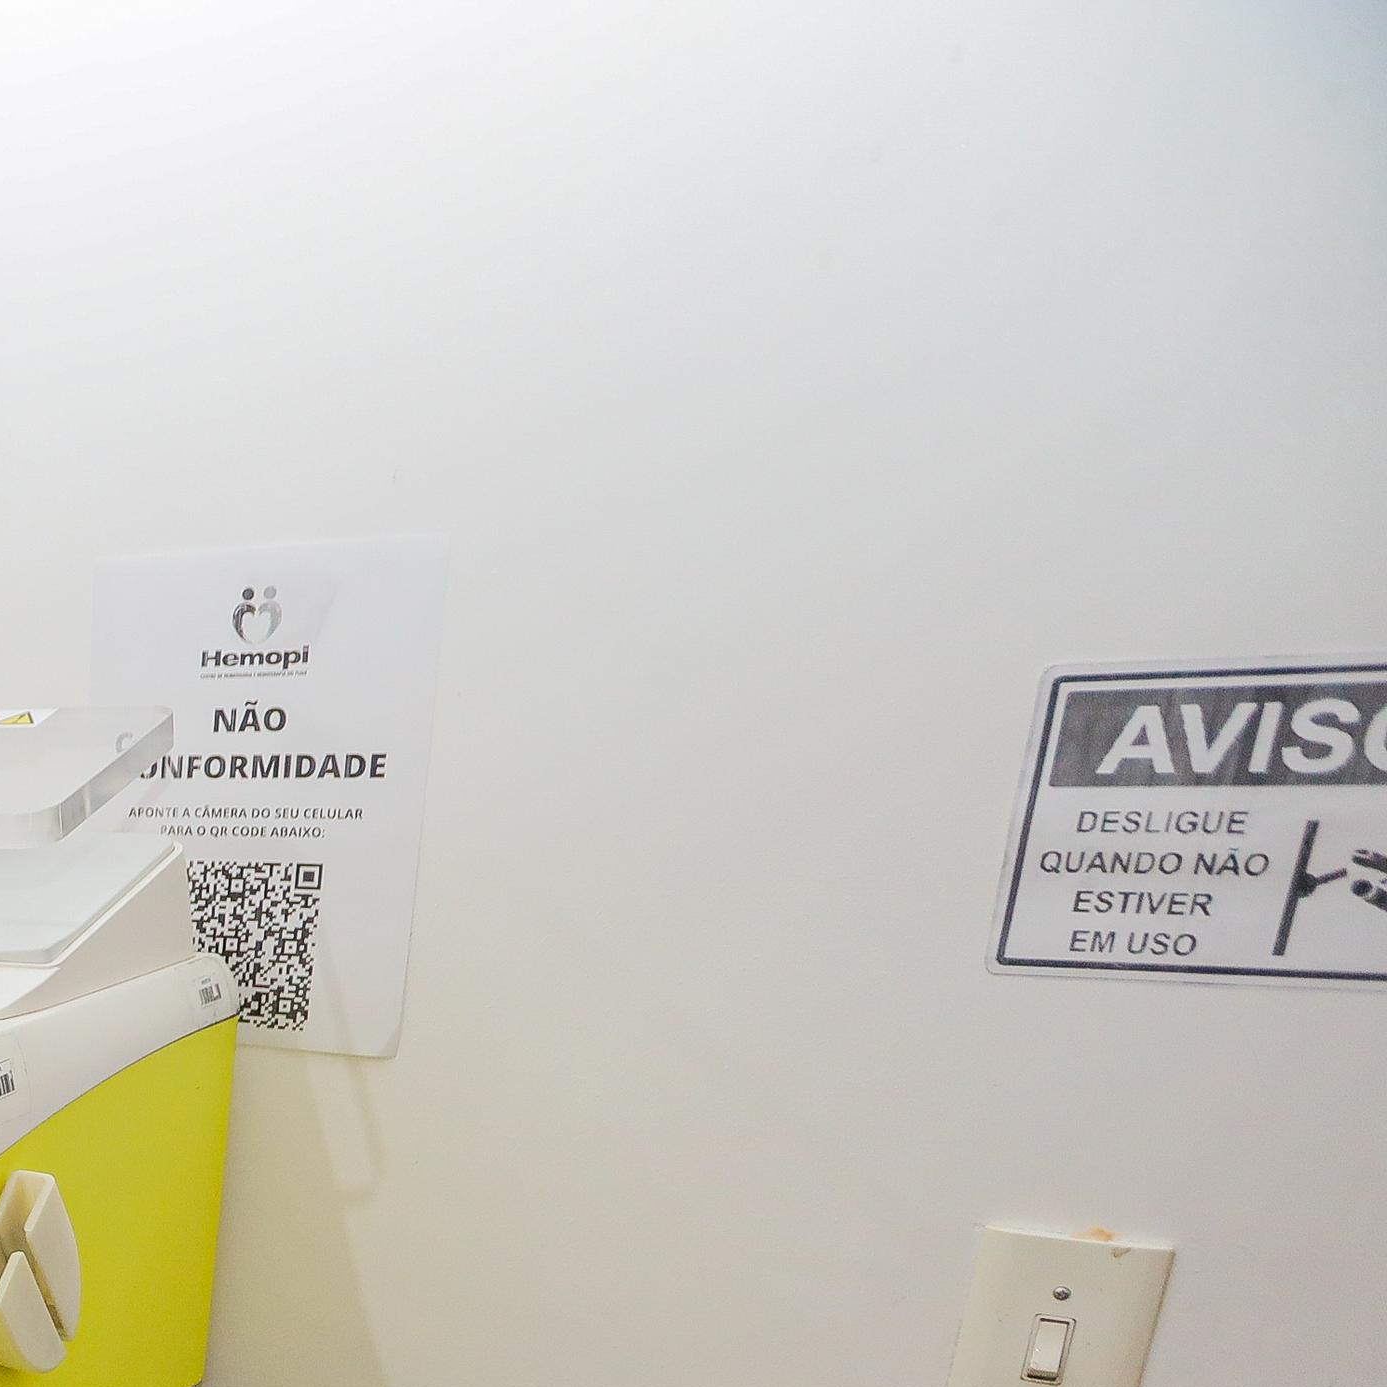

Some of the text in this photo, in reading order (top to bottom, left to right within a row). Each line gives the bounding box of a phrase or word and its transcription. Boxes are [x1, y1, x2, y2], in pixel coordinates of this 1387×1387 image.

[201, 645, 309, 669] Hemopi
[213, 700, 287, 733] NÃO
[1094, 697, 1387, 775] AVIS
[128, 804, 364, 820] APONTE A CÂMERA DO SEU CELULAR
[1076, 810, 1250, 835] DESLIGUE
[160, 825, 193, 836] PARA
[196, 825, 206, 836] O
[210, 825, 228, 838] QR
[232, 826, 267, 838] CODE
[1039, 847, 1270, 877] QUANDO NÃO
[1072, 890, 1214, 917] ESTIVER
[1068, 929, 1198, 957] EM USO
